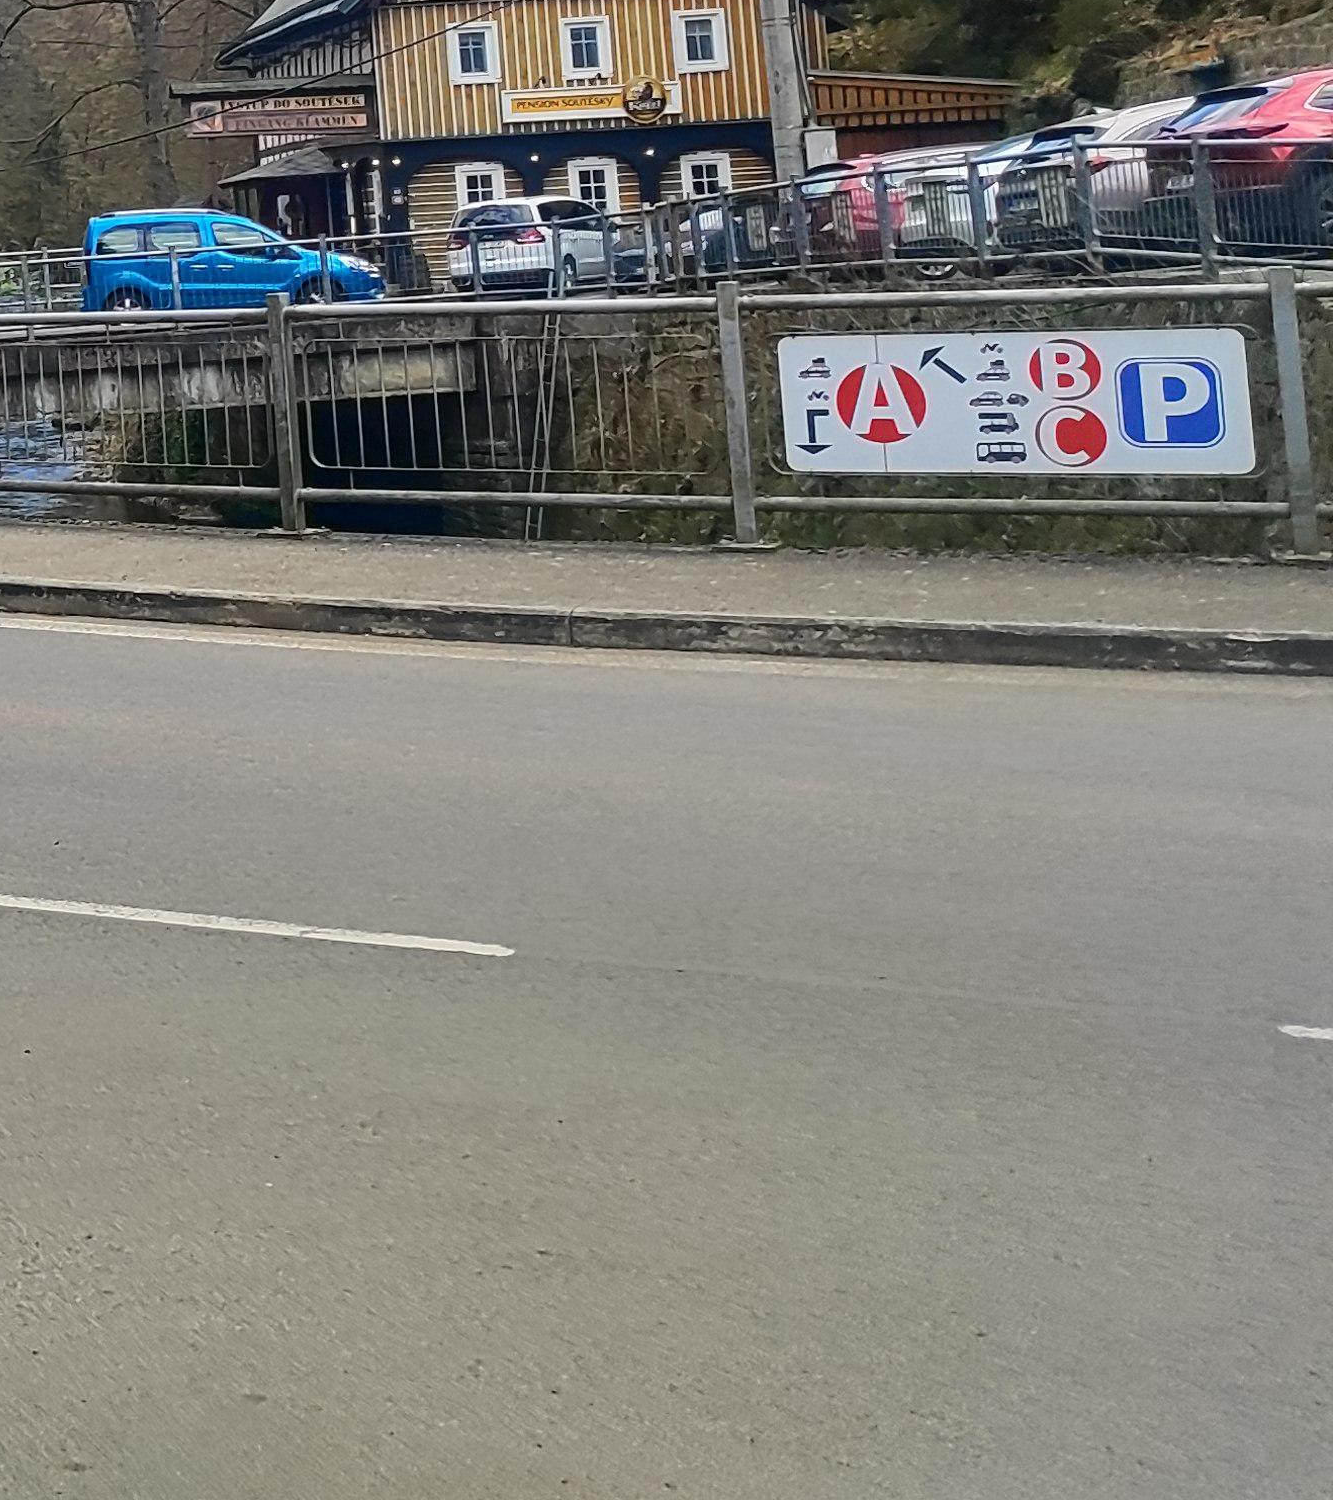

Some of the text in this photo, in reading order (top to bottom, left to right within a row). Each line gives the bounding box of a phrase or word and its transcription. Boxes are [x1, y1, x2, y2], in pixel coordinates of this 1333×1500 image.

[849, 363, 915, 437] A
[1039, 342, 1090, 398] B
[1137, 363, 1210, 442] P
[1037, 407, 1092, 465] C
